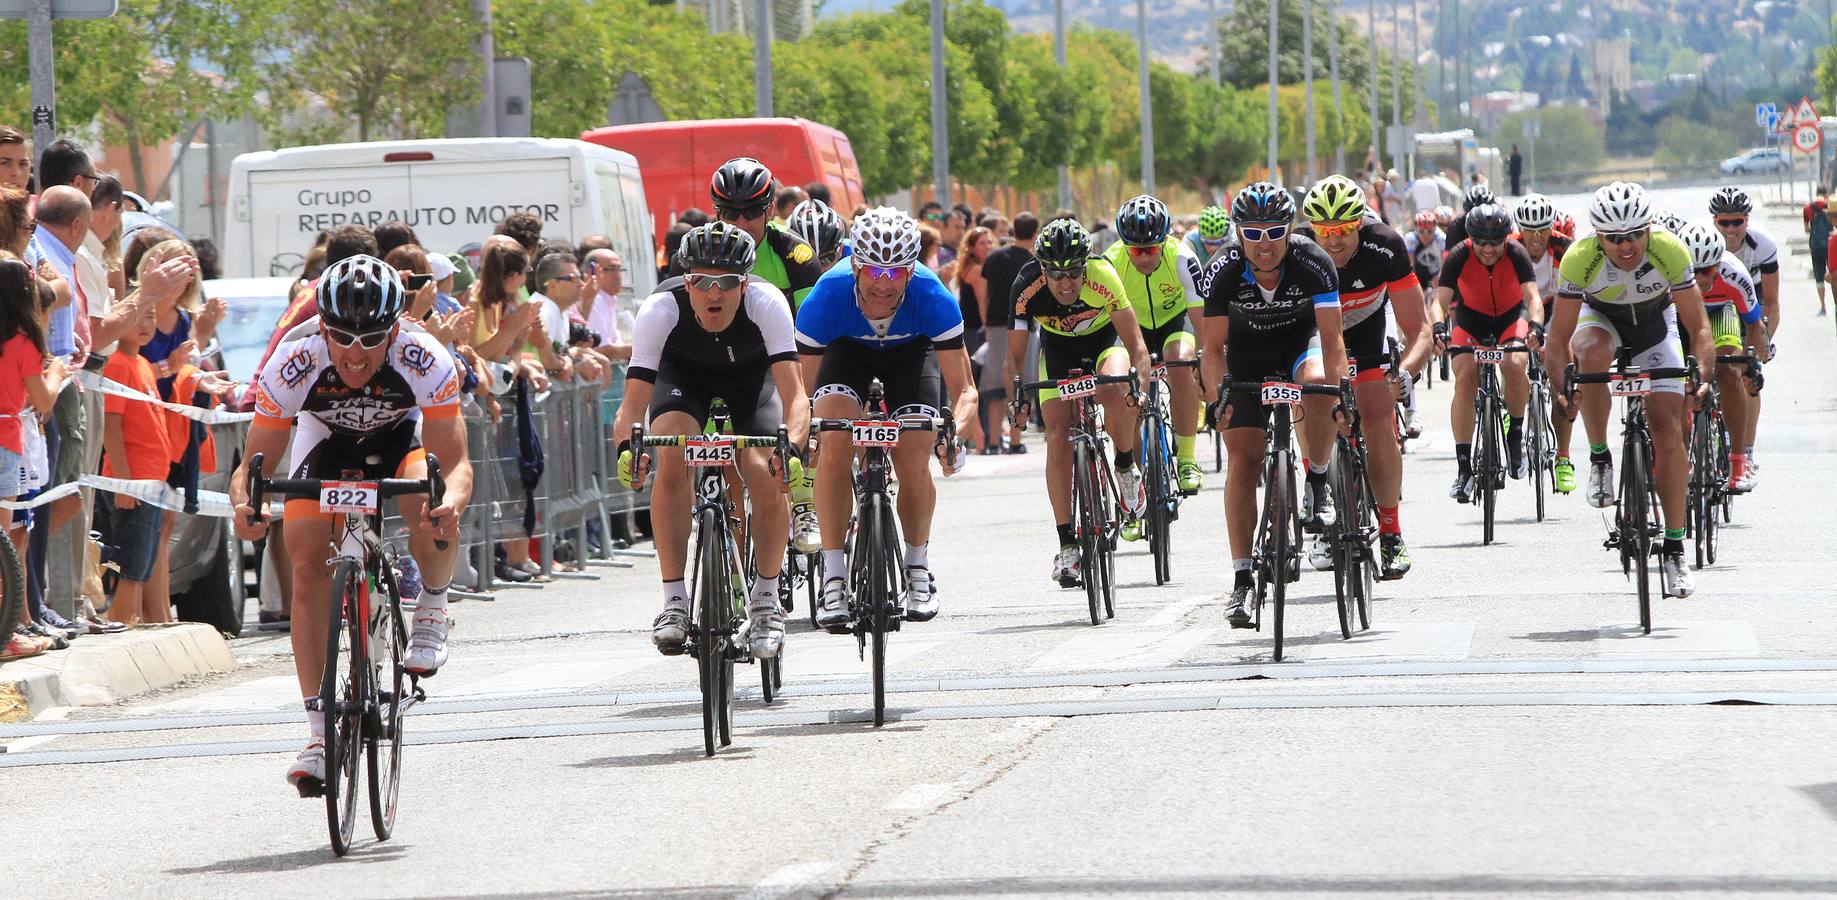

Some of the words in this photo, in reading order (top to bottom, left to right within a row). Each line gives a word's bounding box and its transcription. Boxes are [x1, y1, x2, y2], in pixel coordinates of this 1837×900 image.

[298, 189, 371, 207] Grupo
[1363, 241, 1394, 259] MMR
[1202, 255, 1229, 298] COLOR
[1229, 249, 1241, 261] Q
[1721, 268, 1738, 281] LA
[403, 344, 436, 370] GU
[280, 350, 312, 383] GU
[1059, 379, 1095, 396] 1848
[1262, 387, 1300, 401] 1355
[1615, 379, 1644, 392] 417
[853, 427, 897, 442] 1165
[686, 447, 732, 461] 1445
[326, 489, 368, 506] 822
